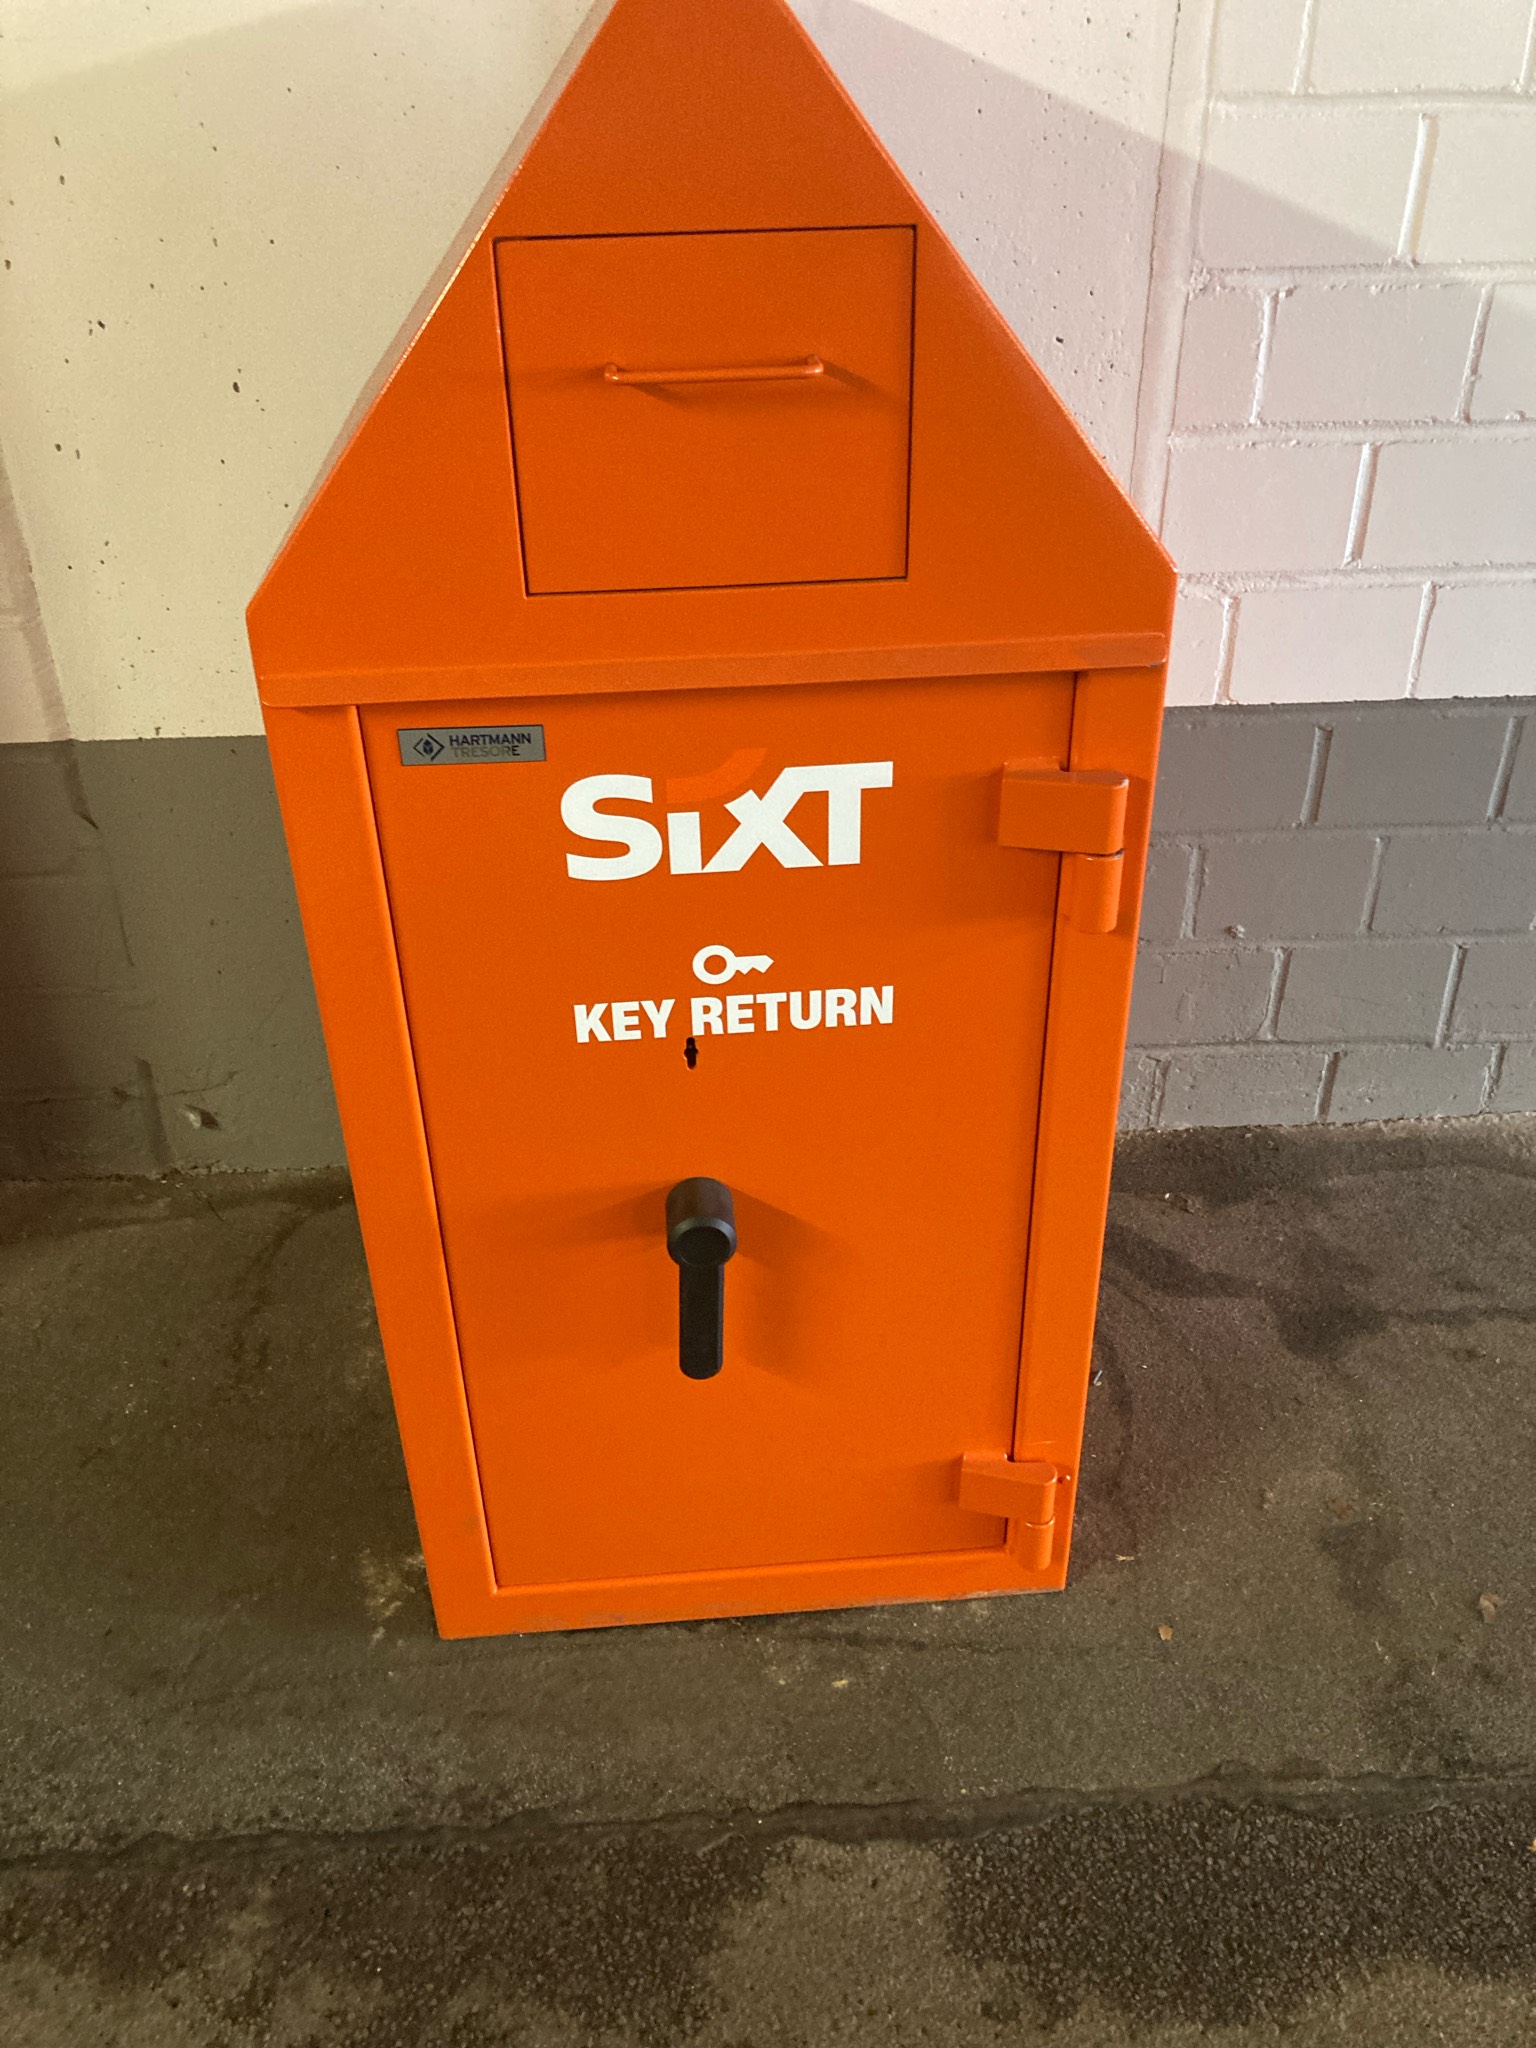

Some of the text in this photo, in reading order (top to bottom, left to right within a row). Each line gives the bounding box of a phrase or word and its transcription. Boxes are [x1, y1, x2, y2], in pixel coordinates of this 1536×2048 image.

[449, 733, 532, 746] HARTMANN
[451, 745, 520, 758] TRESORE
[573, 985, 894, 1043] KEY RETURN
